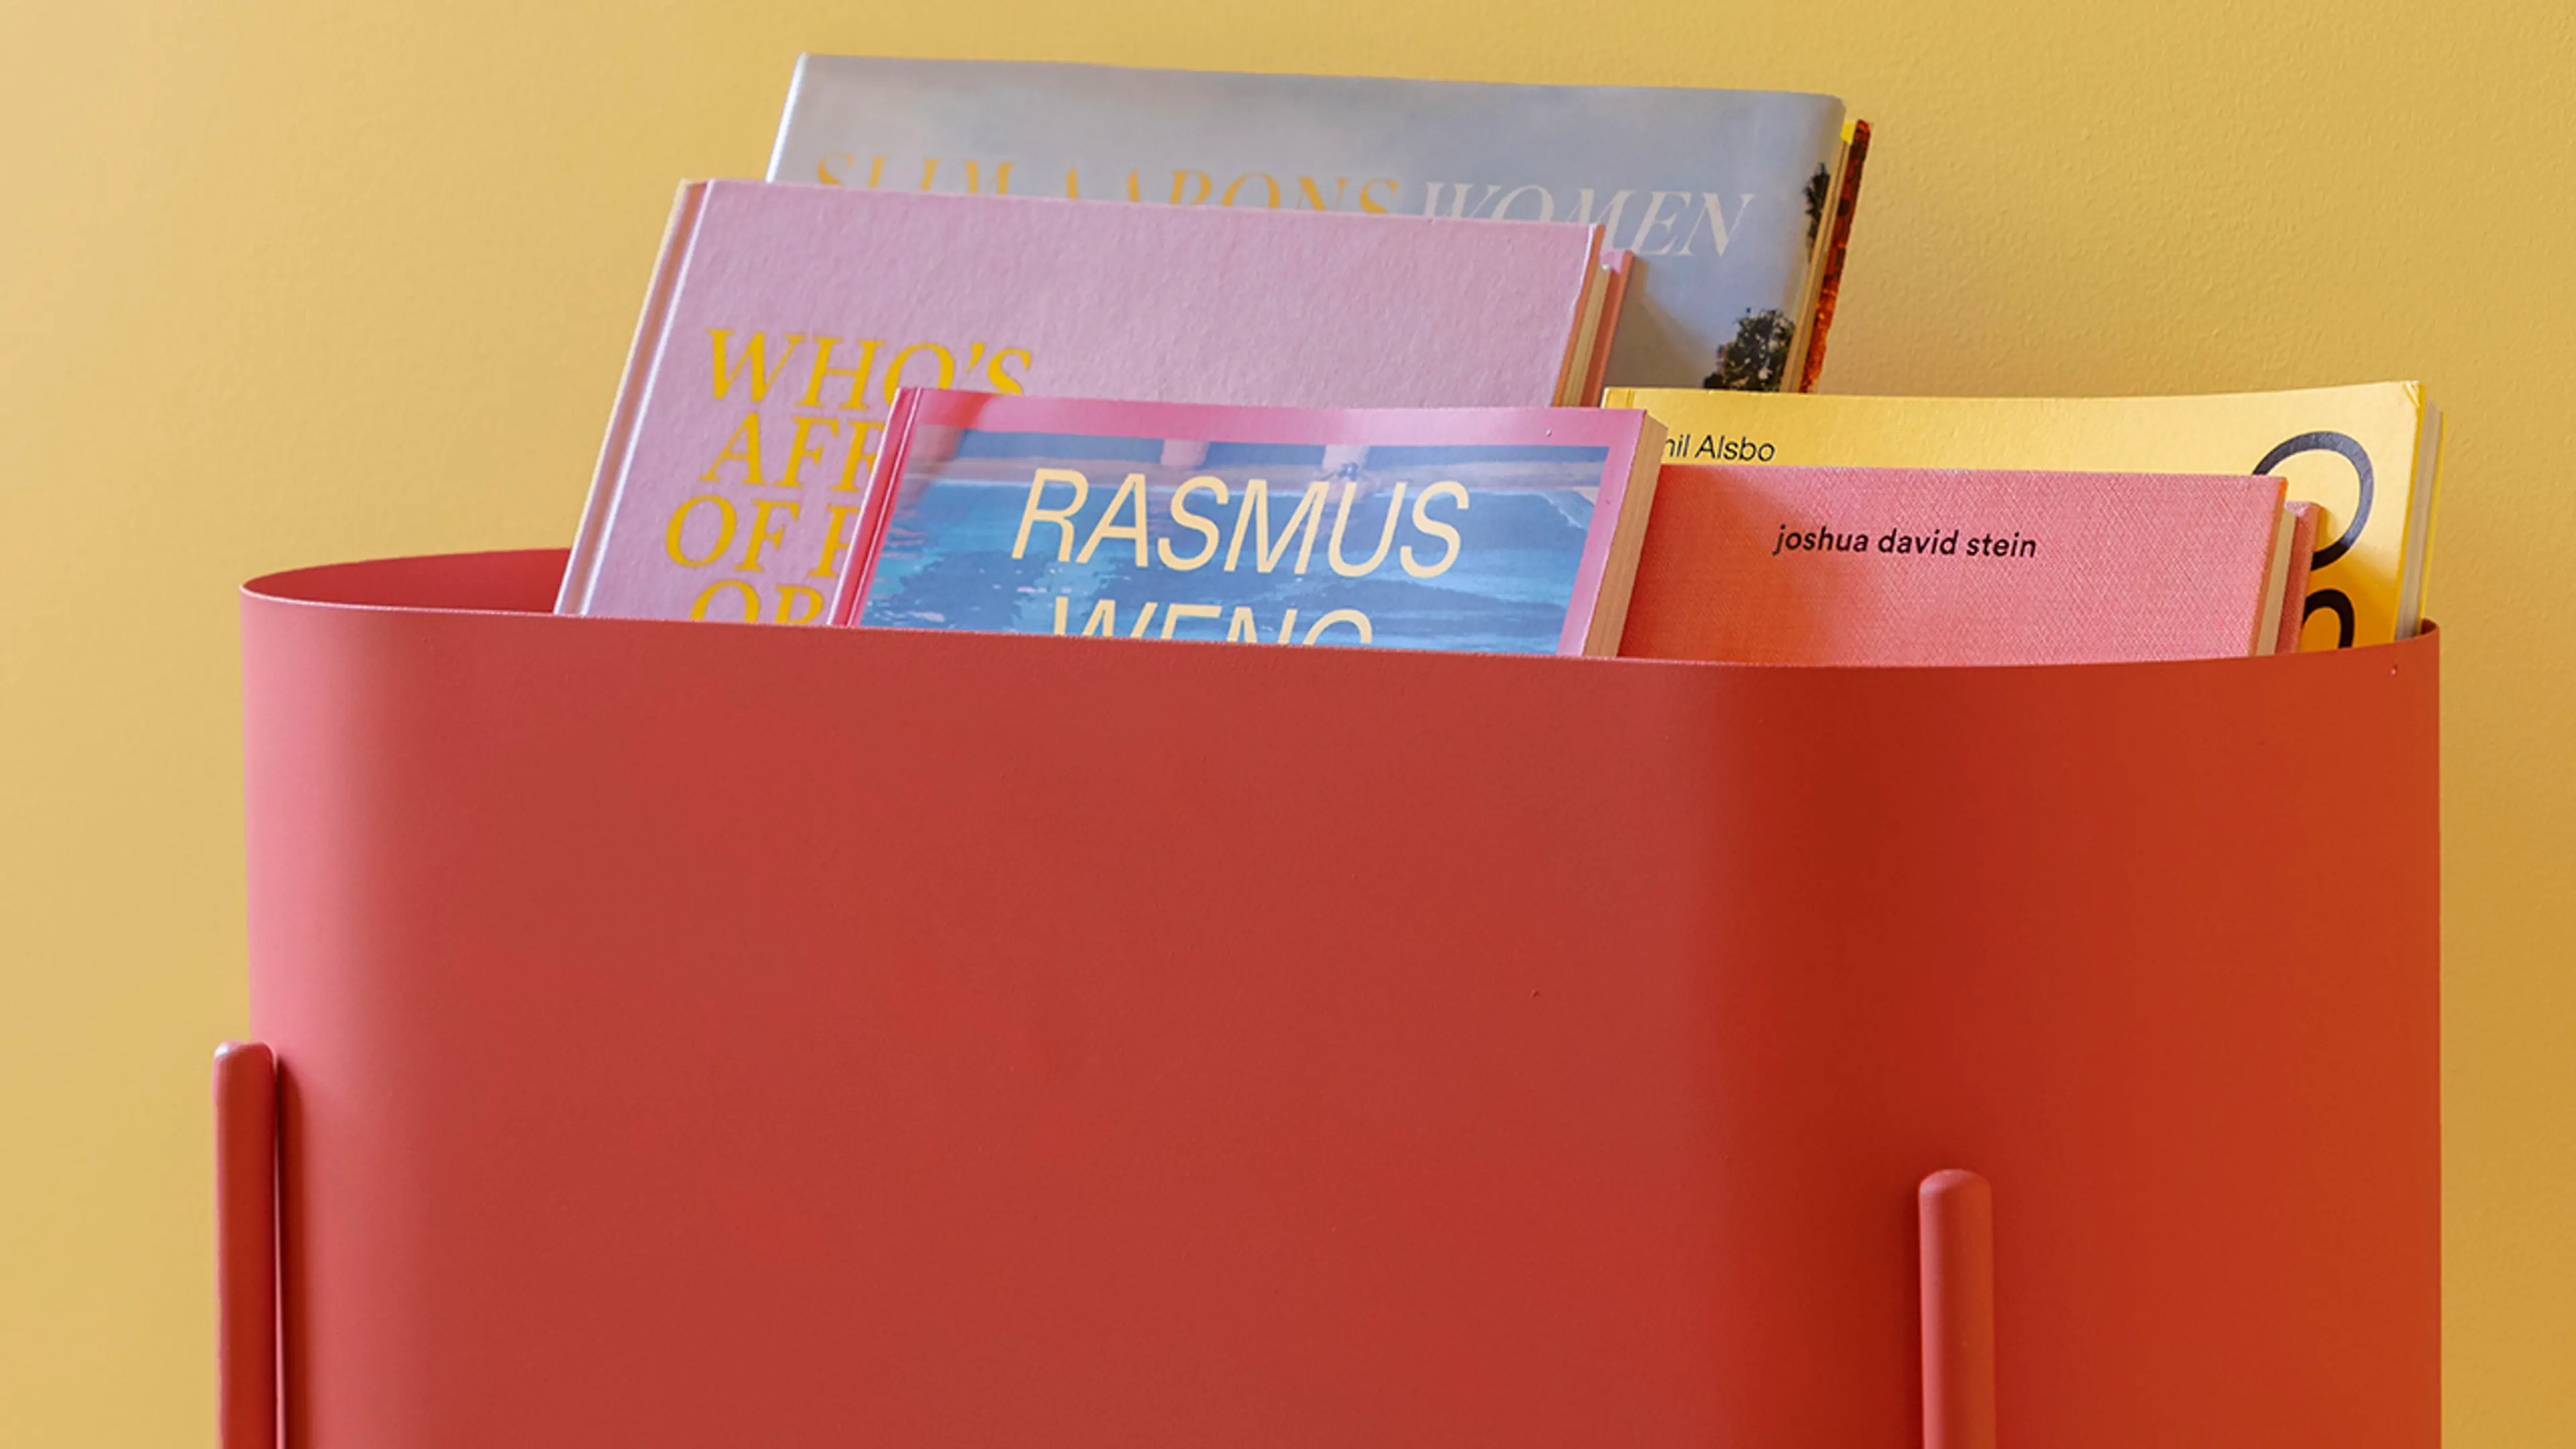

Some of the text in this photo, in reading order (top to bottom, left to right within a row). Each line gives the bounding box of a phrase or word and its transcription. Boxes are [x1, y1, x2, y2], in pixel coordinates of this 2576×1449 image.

[1422, 181, 1756, 258] WOMEN
[706, 328, 1032, 411] WHO'S
[1695, 434, 1776, 462] Alsbo
[664, 494, 800, 572] OF
[1011, 468, 1470, 579] RASMUS
[1772, 524, 2037, 558] joshua david stein
